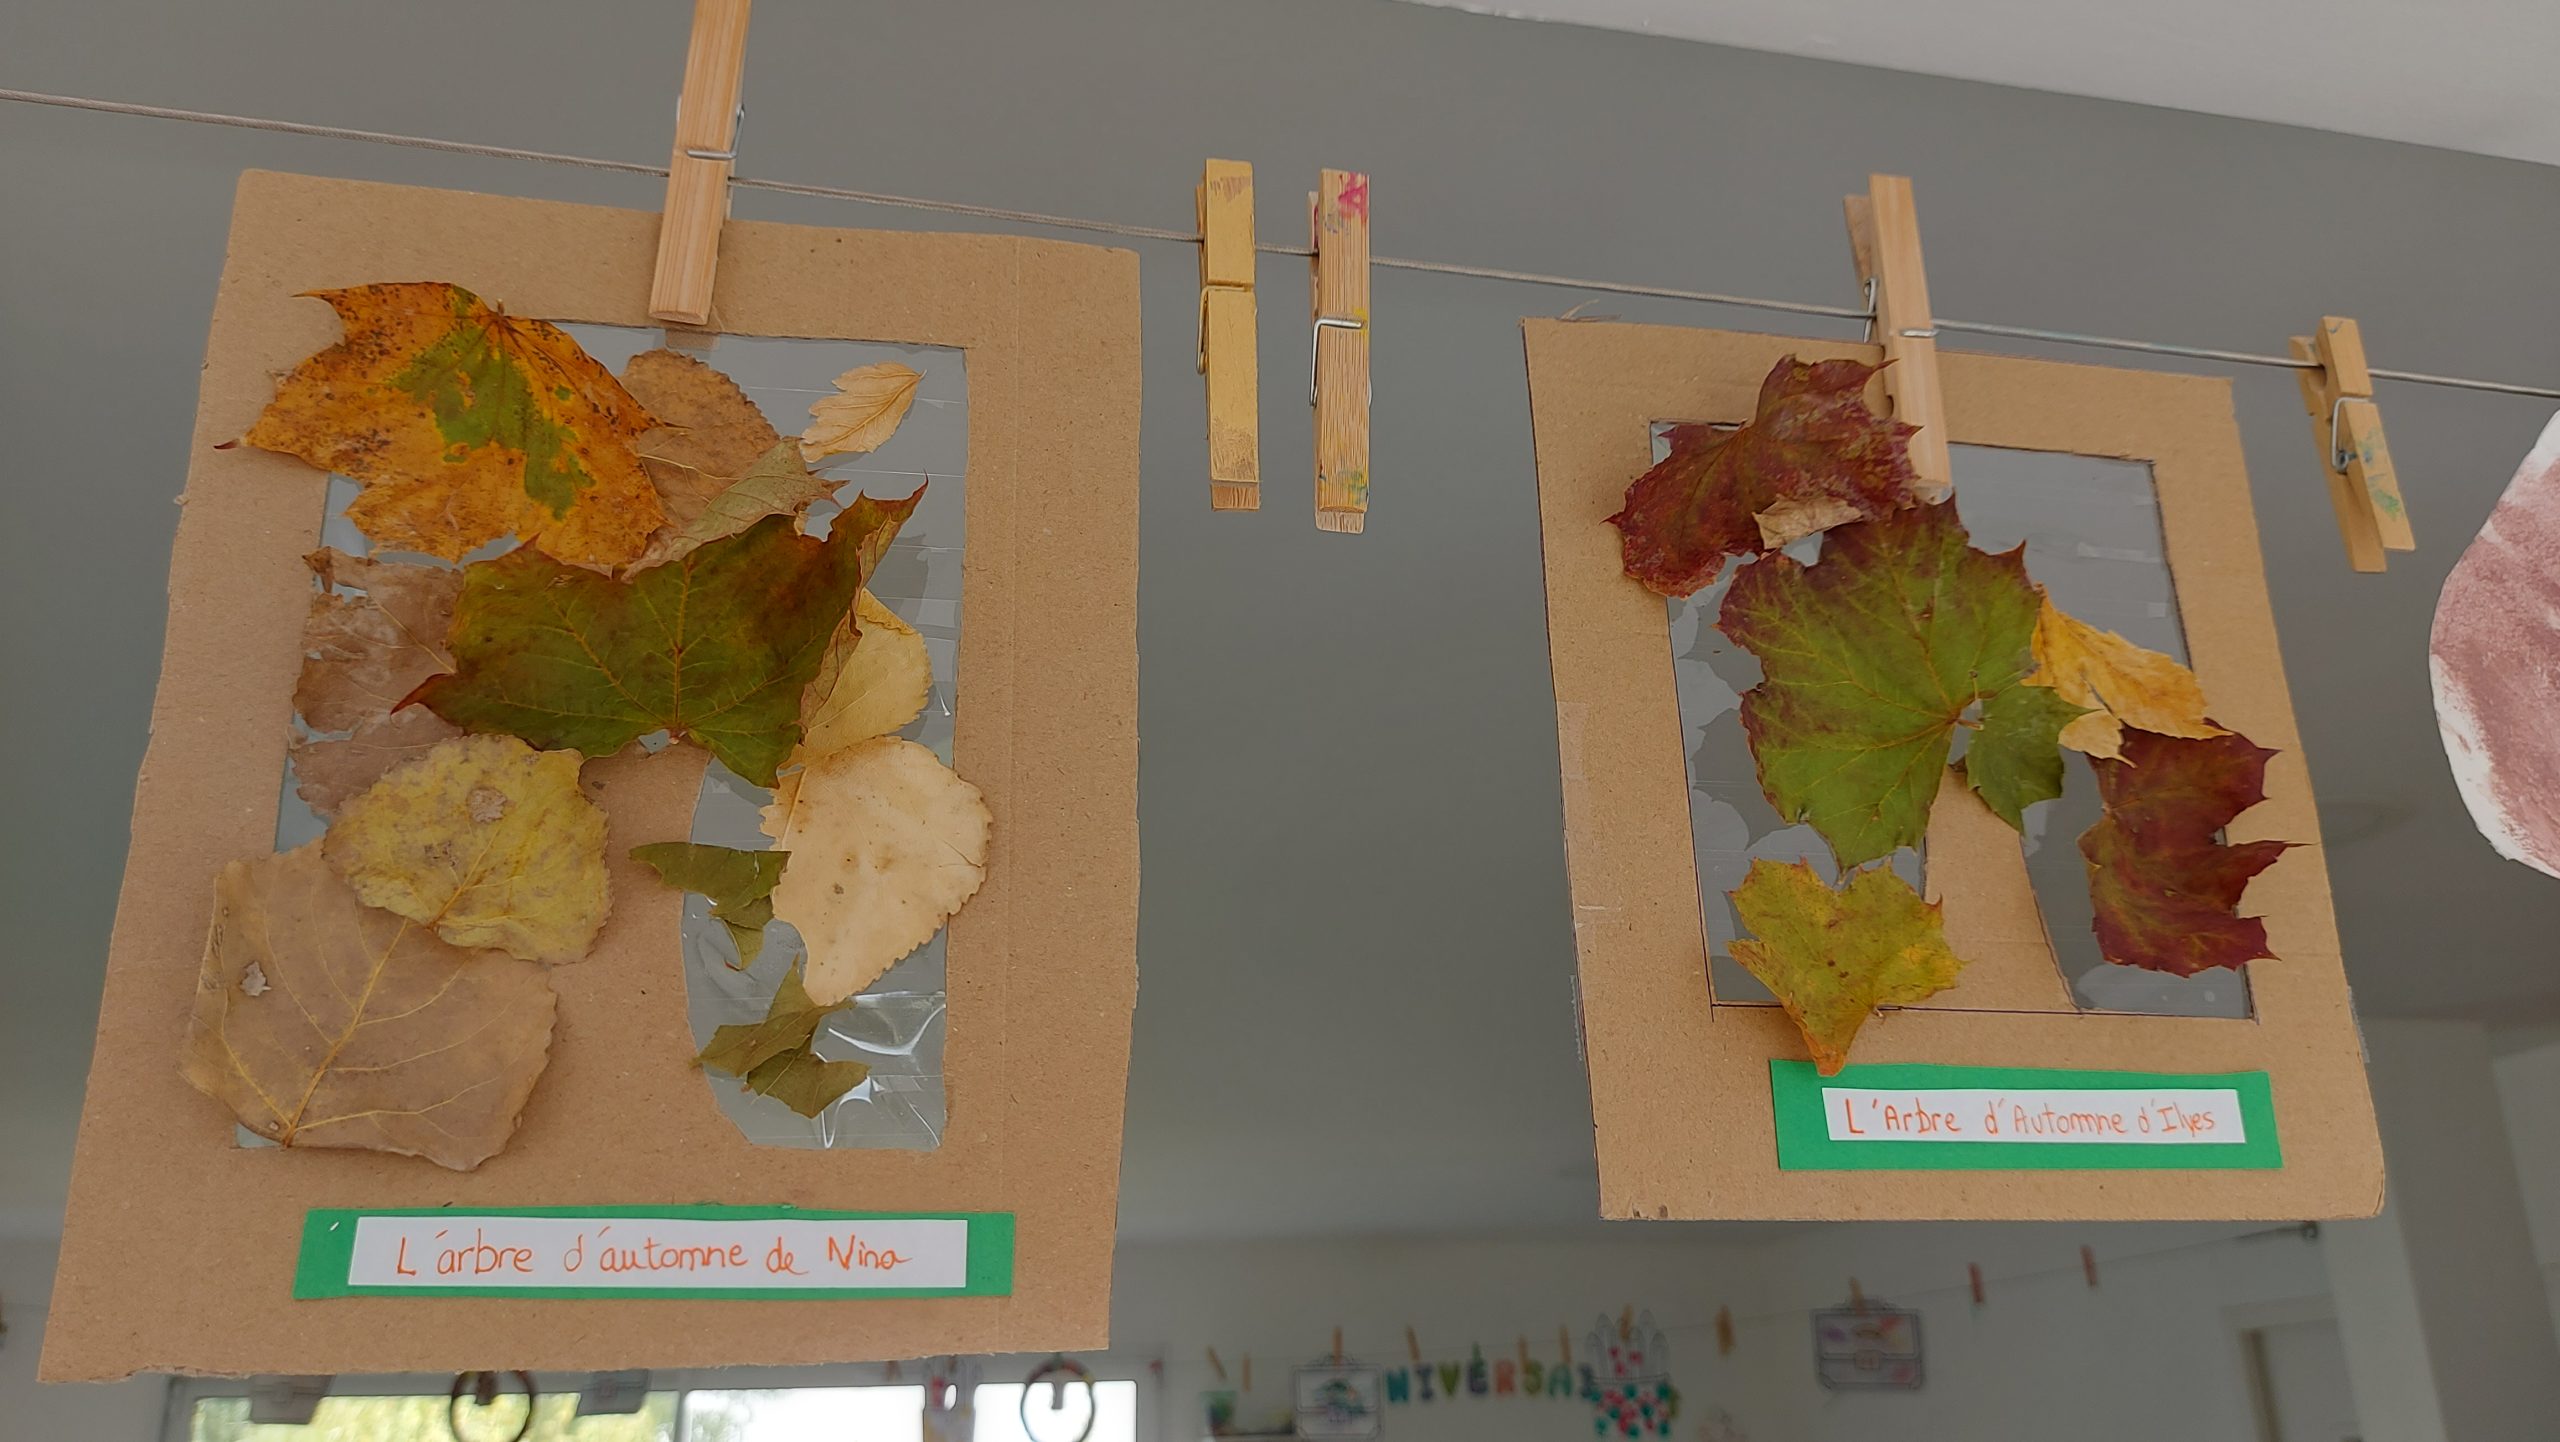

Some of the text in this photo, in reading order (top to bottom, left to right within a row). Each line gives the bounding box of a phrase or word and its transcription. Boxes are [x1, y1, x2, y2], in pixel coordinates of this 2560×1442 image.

[1843, 1097, 1962, 1136] L'Arbre
[1983, 1098, 2127, 1137] d'Automne
[763, 1235, 810, 1276] de
[826, 1232, 910, 1272] Nina
